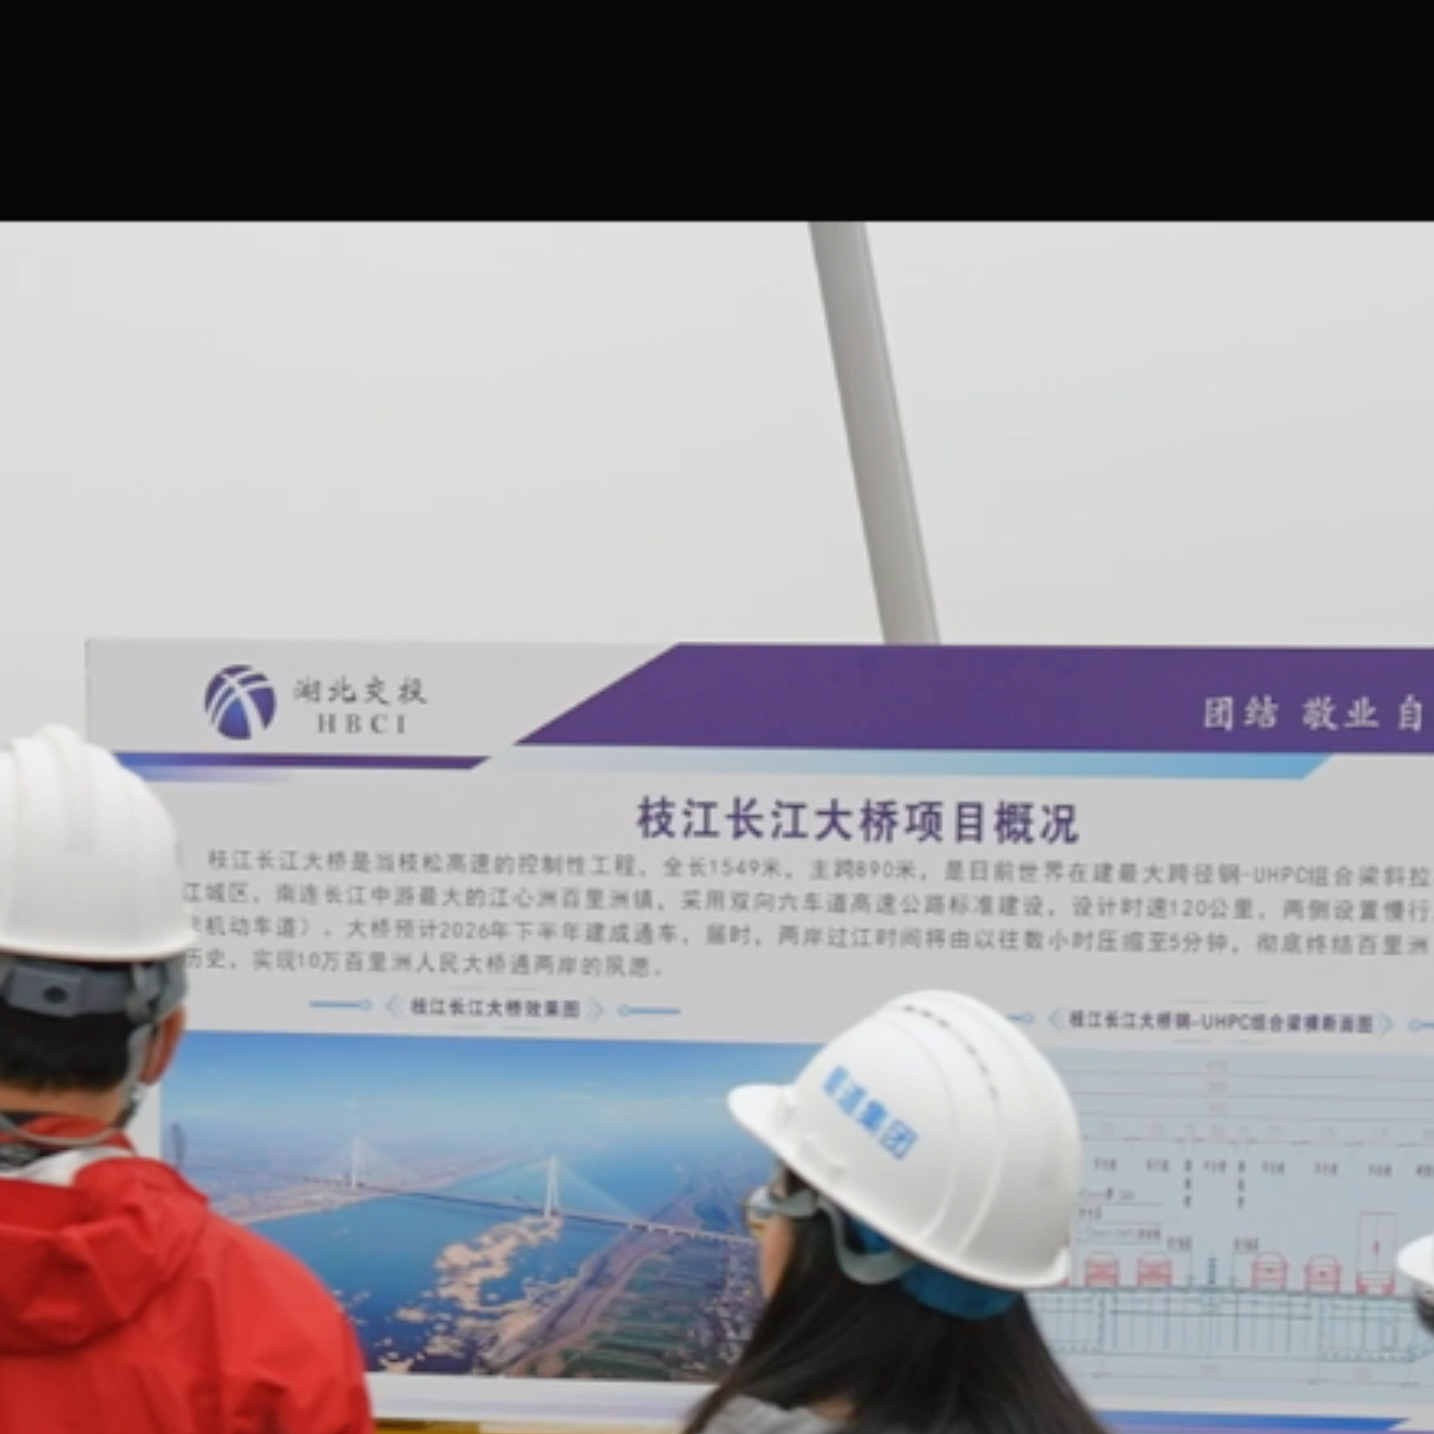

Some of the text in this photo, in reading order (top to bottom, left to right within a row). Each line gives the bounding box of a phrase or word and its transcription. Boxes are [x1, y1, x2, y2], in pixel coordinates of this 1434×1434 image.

[293, 676, 428, 705] 湖北交投
[316, 713, 407, 735] HBCI
[1203, 696, 1279, 731] 团结
[1302, 696, 1380, 731] 敬业
[636, 796, 1081, 844] 枝江长江大桥项目概况
[410, 996, 581, 1019] 枝江长江大桥效果图
